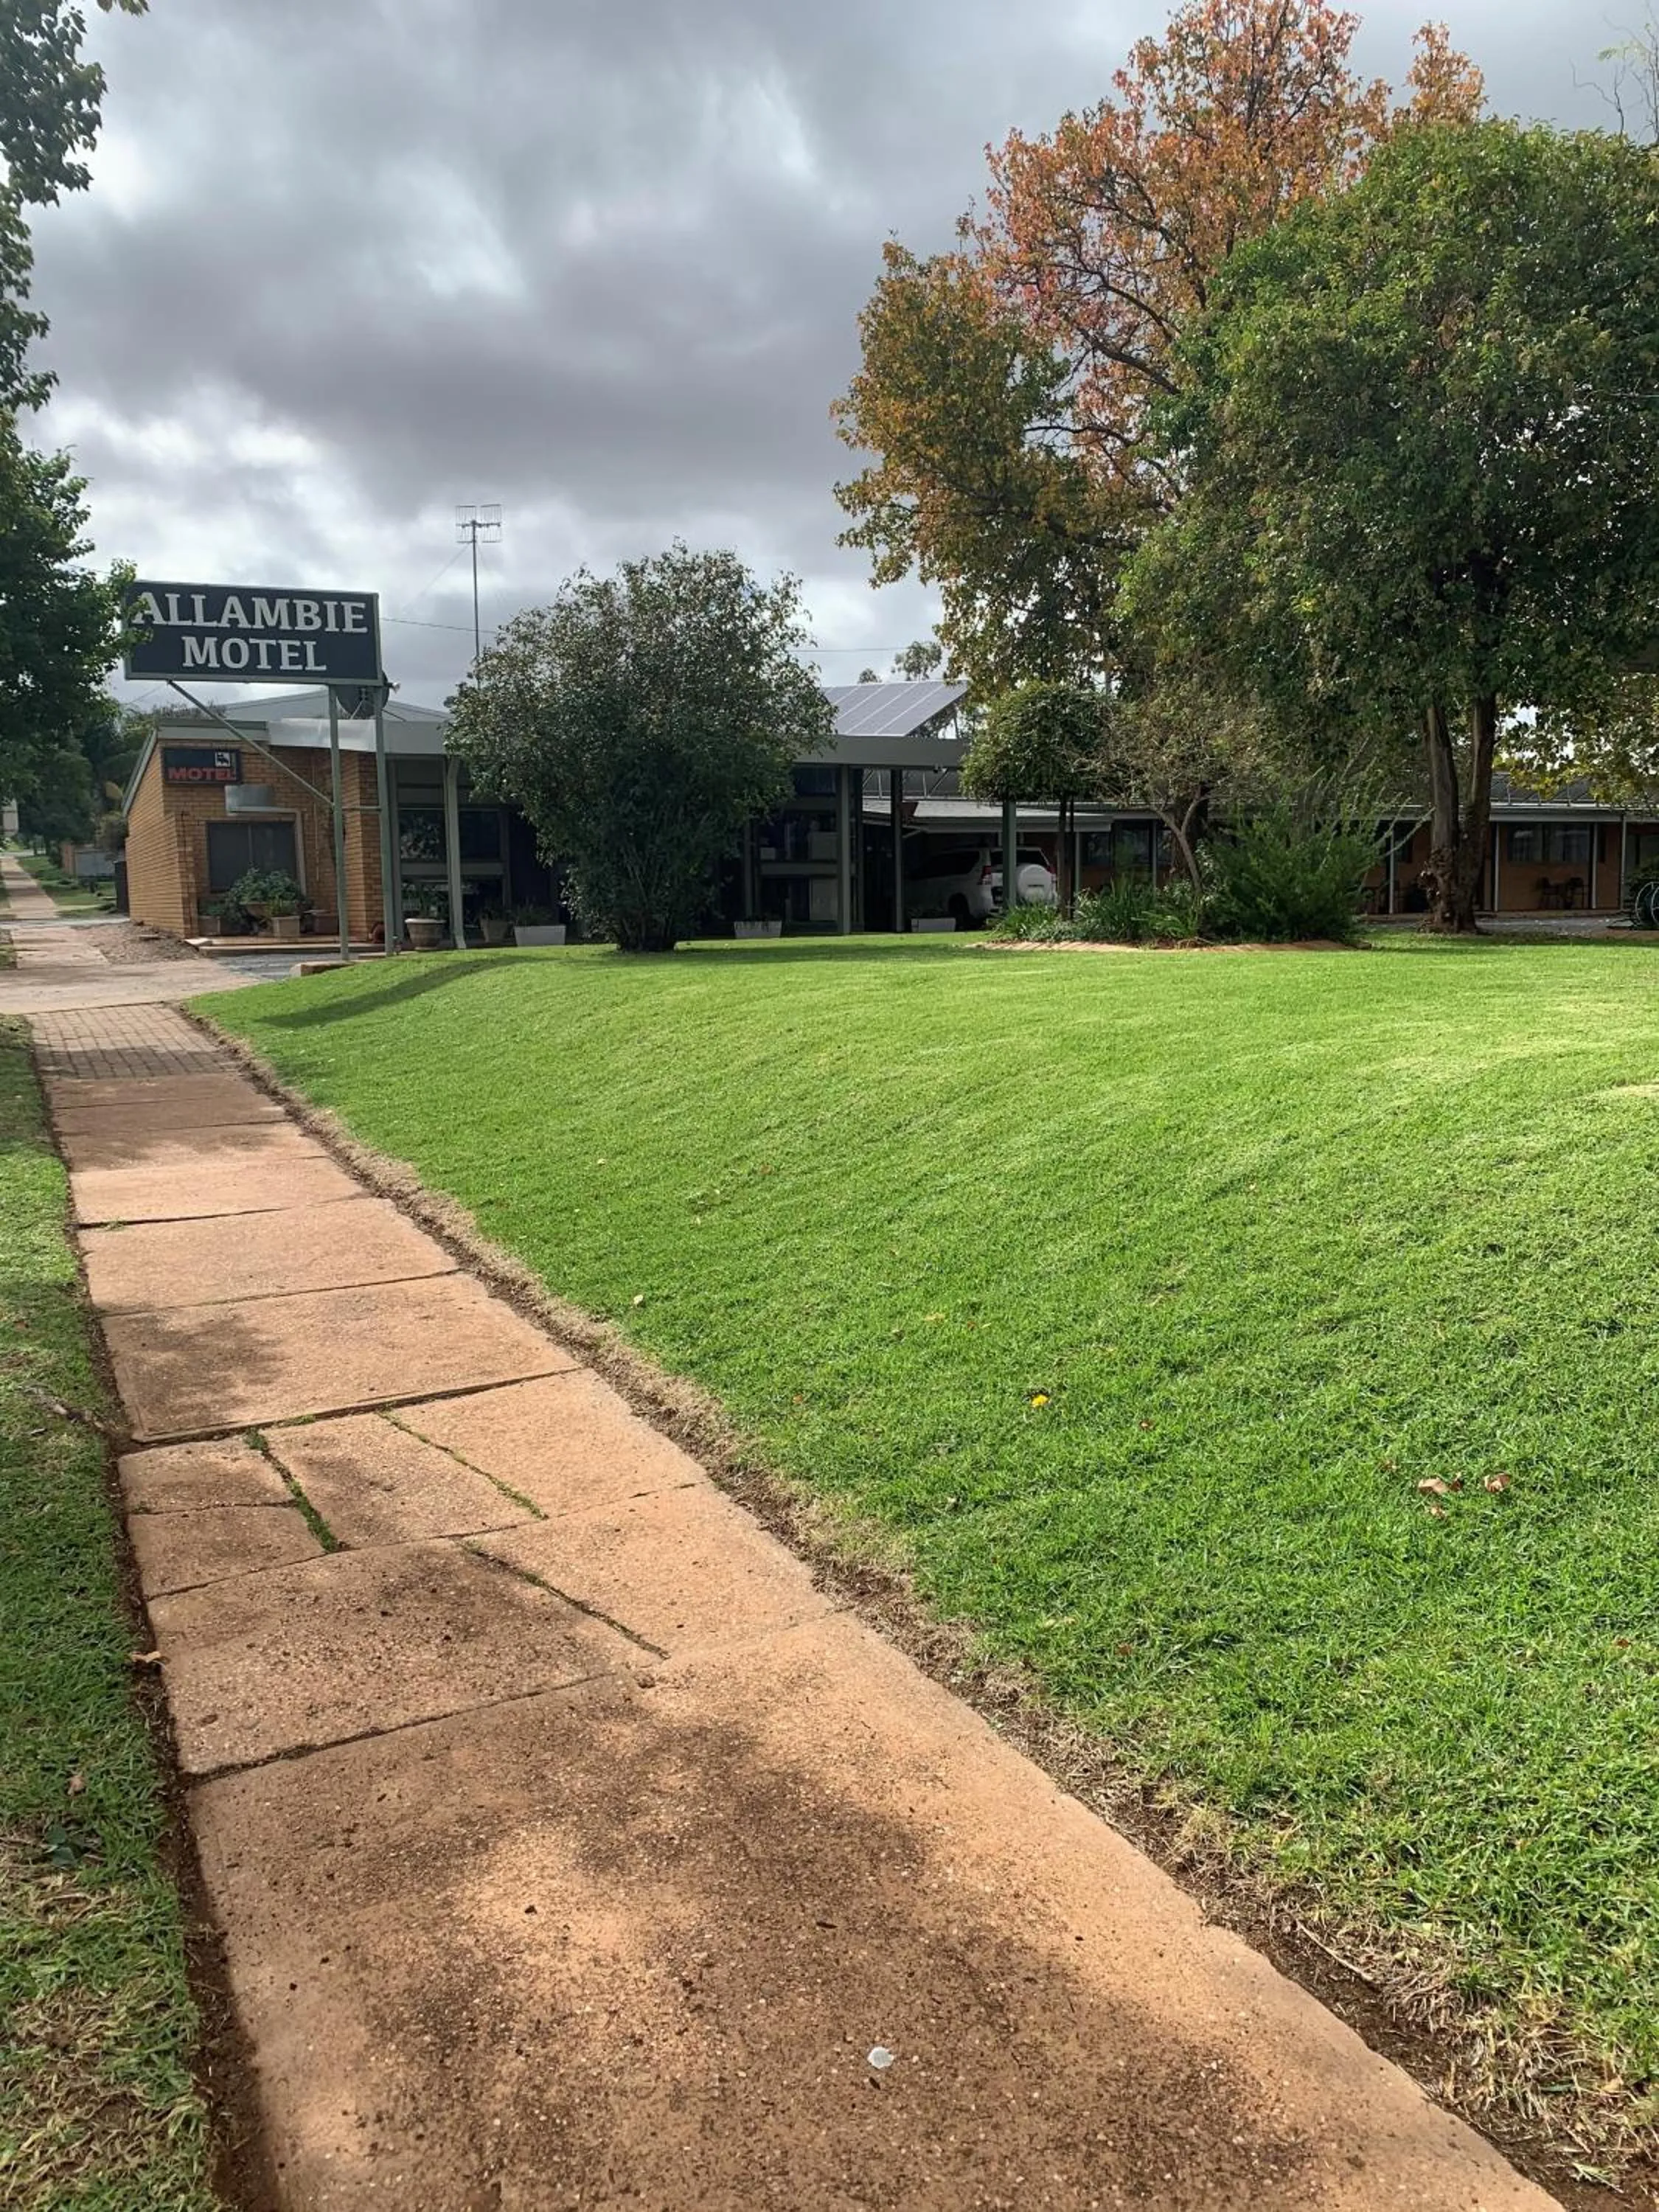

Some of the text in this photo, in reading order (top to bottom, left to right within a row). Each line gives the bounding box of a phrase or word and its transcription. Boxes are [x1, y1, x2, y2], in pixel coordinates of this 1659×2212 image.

[132, 592, 368, 633] ALLAMBIE
[182, 636, 327, 671] MOTEL
[168, 767, 237, 781] MOTEL
